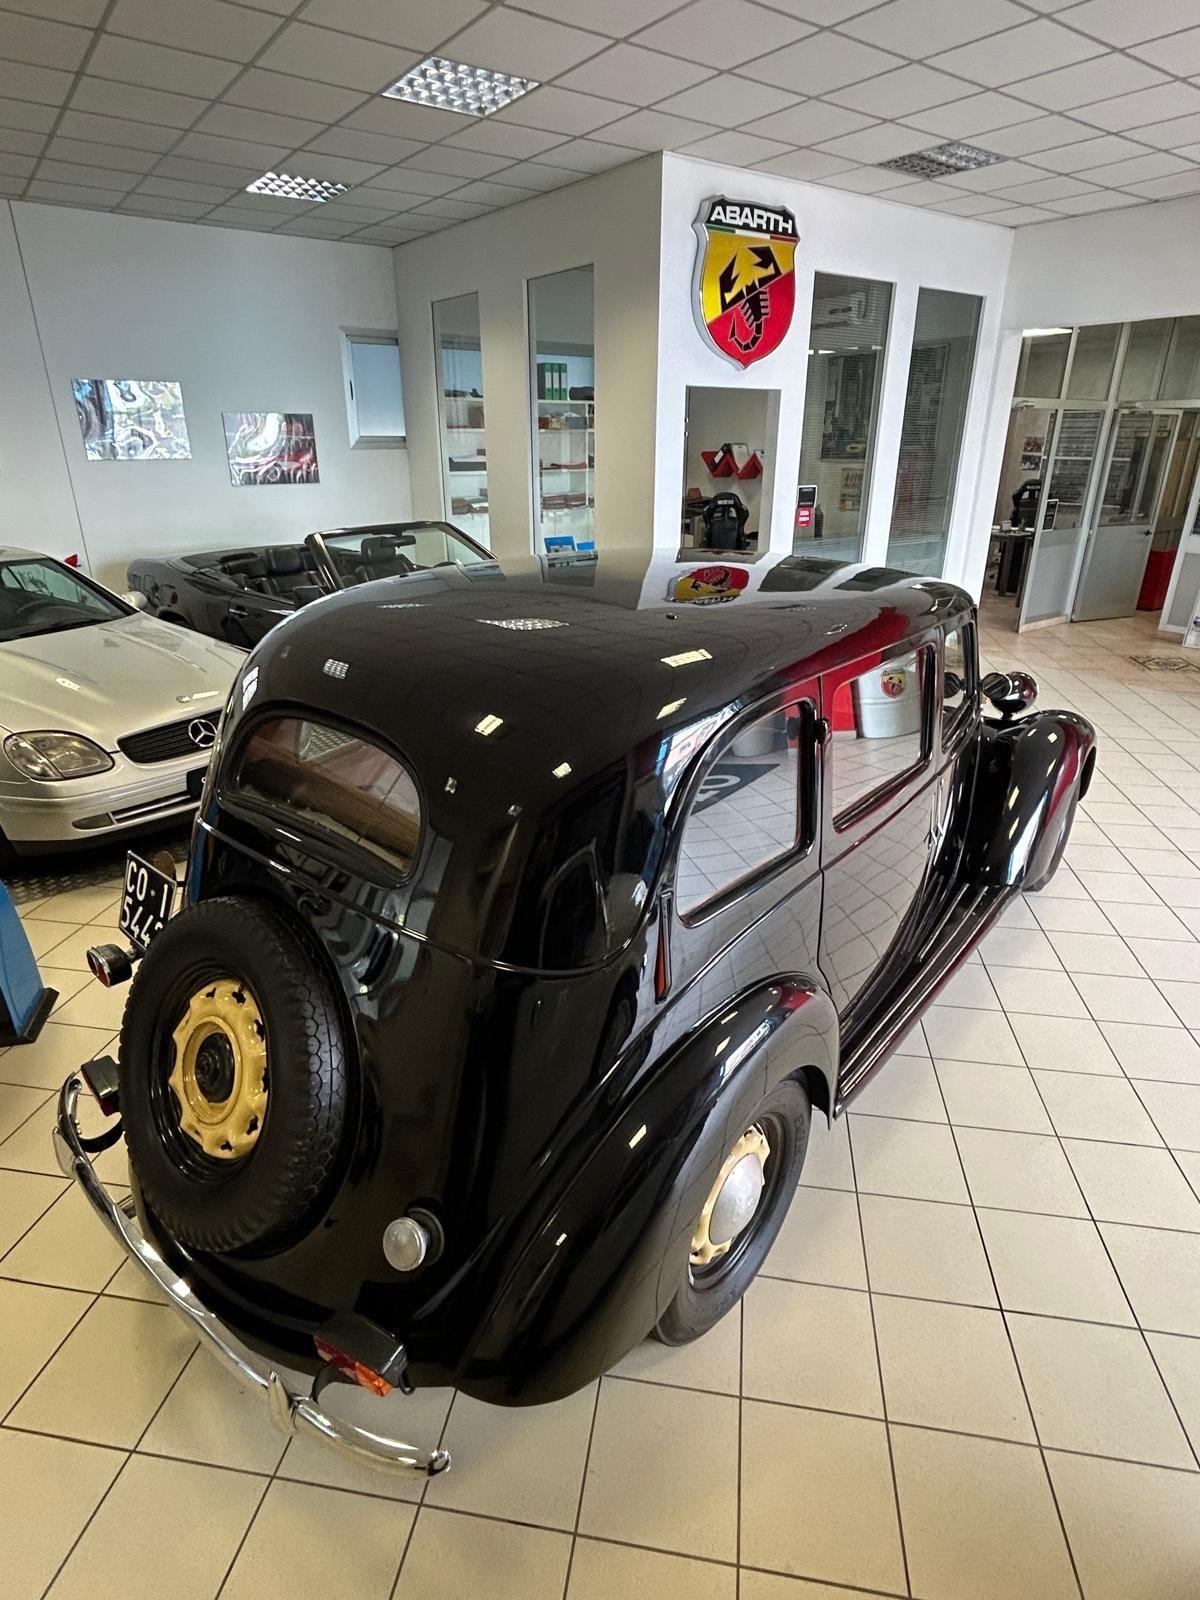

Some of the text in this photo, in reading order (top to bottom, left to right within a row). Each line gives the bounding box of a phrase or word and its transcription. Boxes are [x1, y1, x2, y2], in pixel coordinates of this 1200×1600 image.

[710, 205, 793, 234] ABARTH
[126, 861, 148, 900] CO
[120, 896, 164, 947] 544
